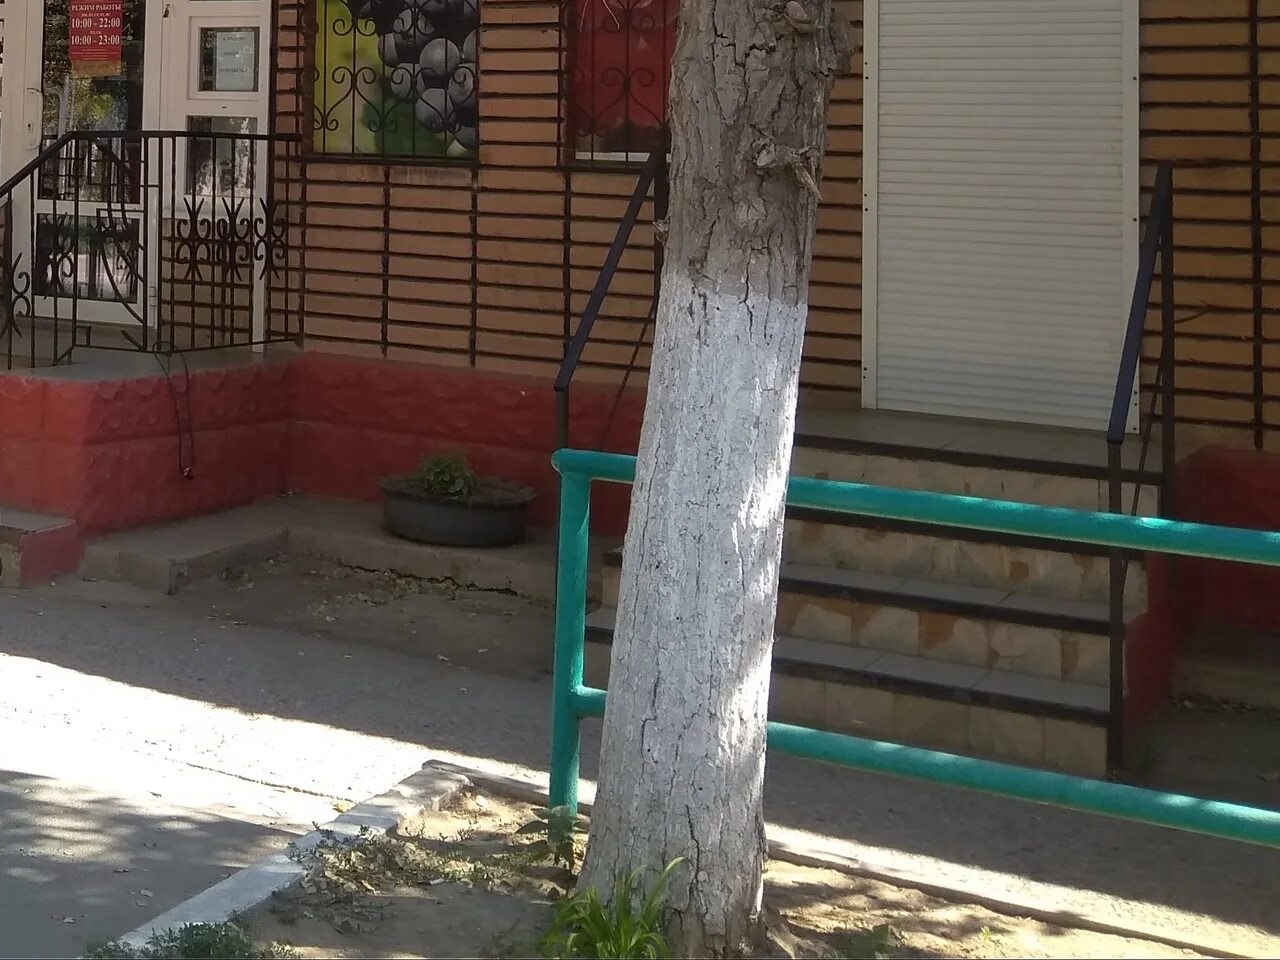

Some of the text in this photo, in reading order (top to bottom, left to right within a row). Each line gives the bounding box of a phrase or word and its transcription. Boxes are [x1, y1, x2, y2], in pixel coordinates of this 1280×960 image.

[71, 18, 92, 28] 10:00
[99, 17, 121, 28] 22:00
[71, 35, 92, 45] 10:00
[98, 34, 120, 45] 23:00
